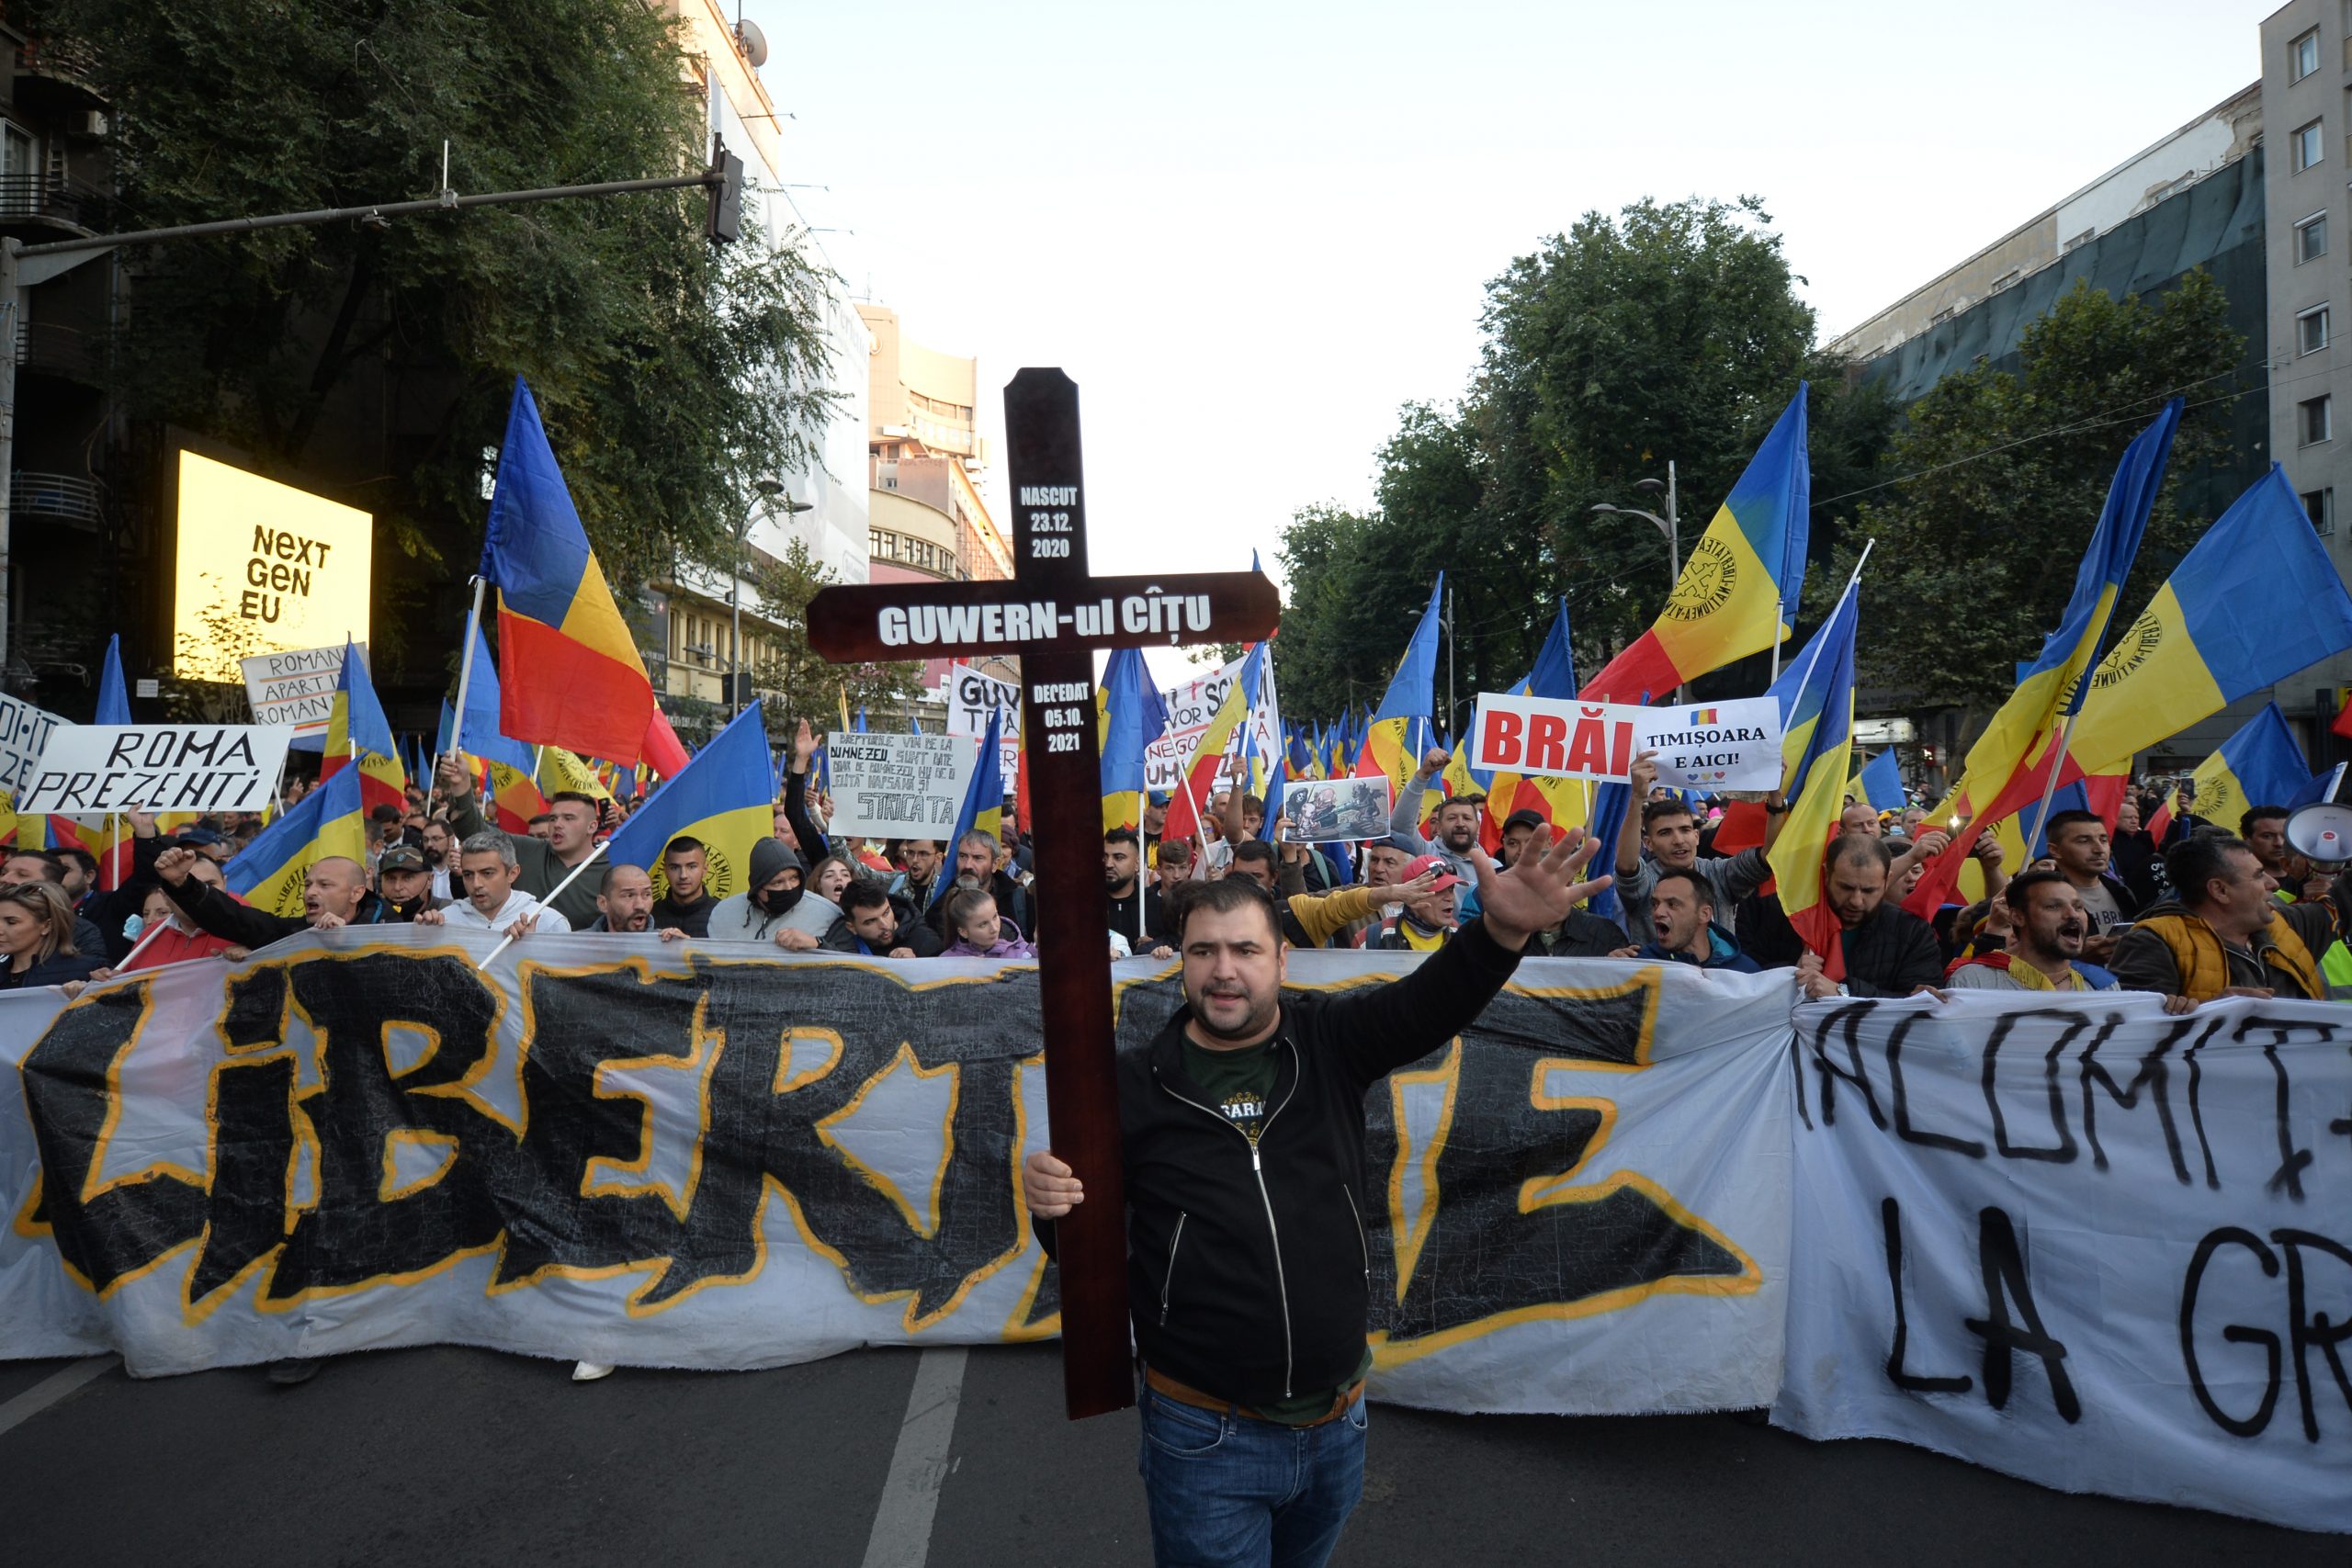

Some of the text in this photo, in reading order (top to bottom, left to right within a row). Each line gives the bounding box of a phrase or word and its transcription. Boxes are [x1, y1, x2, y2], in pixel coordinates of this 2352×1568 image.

[1021, 487, 1078, 506] NASCUT
[1031, 513, 1073, 532] 23.12.
[1032, 538, 1070, 558] 2020
[240, 590, 280, 624] EU
[878, 599, 1114, 646] GUWERN-ul
[1034, 682, 1090, 704] DECEDAT
[1045, 708, 1084, 728] 05.10.
[1169, 707, 1202, 729] VOR
[1048, 733, 1080, 752] 2021
[1481, 706, 1634, 777] BRĂI
[1646, 727, 1767, 748] TIMIȘOARA
[105, 729, 255, 768] ROMA
[1675, 752, 1740, 769] E AICI!
[1881, 1196, 2082, 1424] LA
